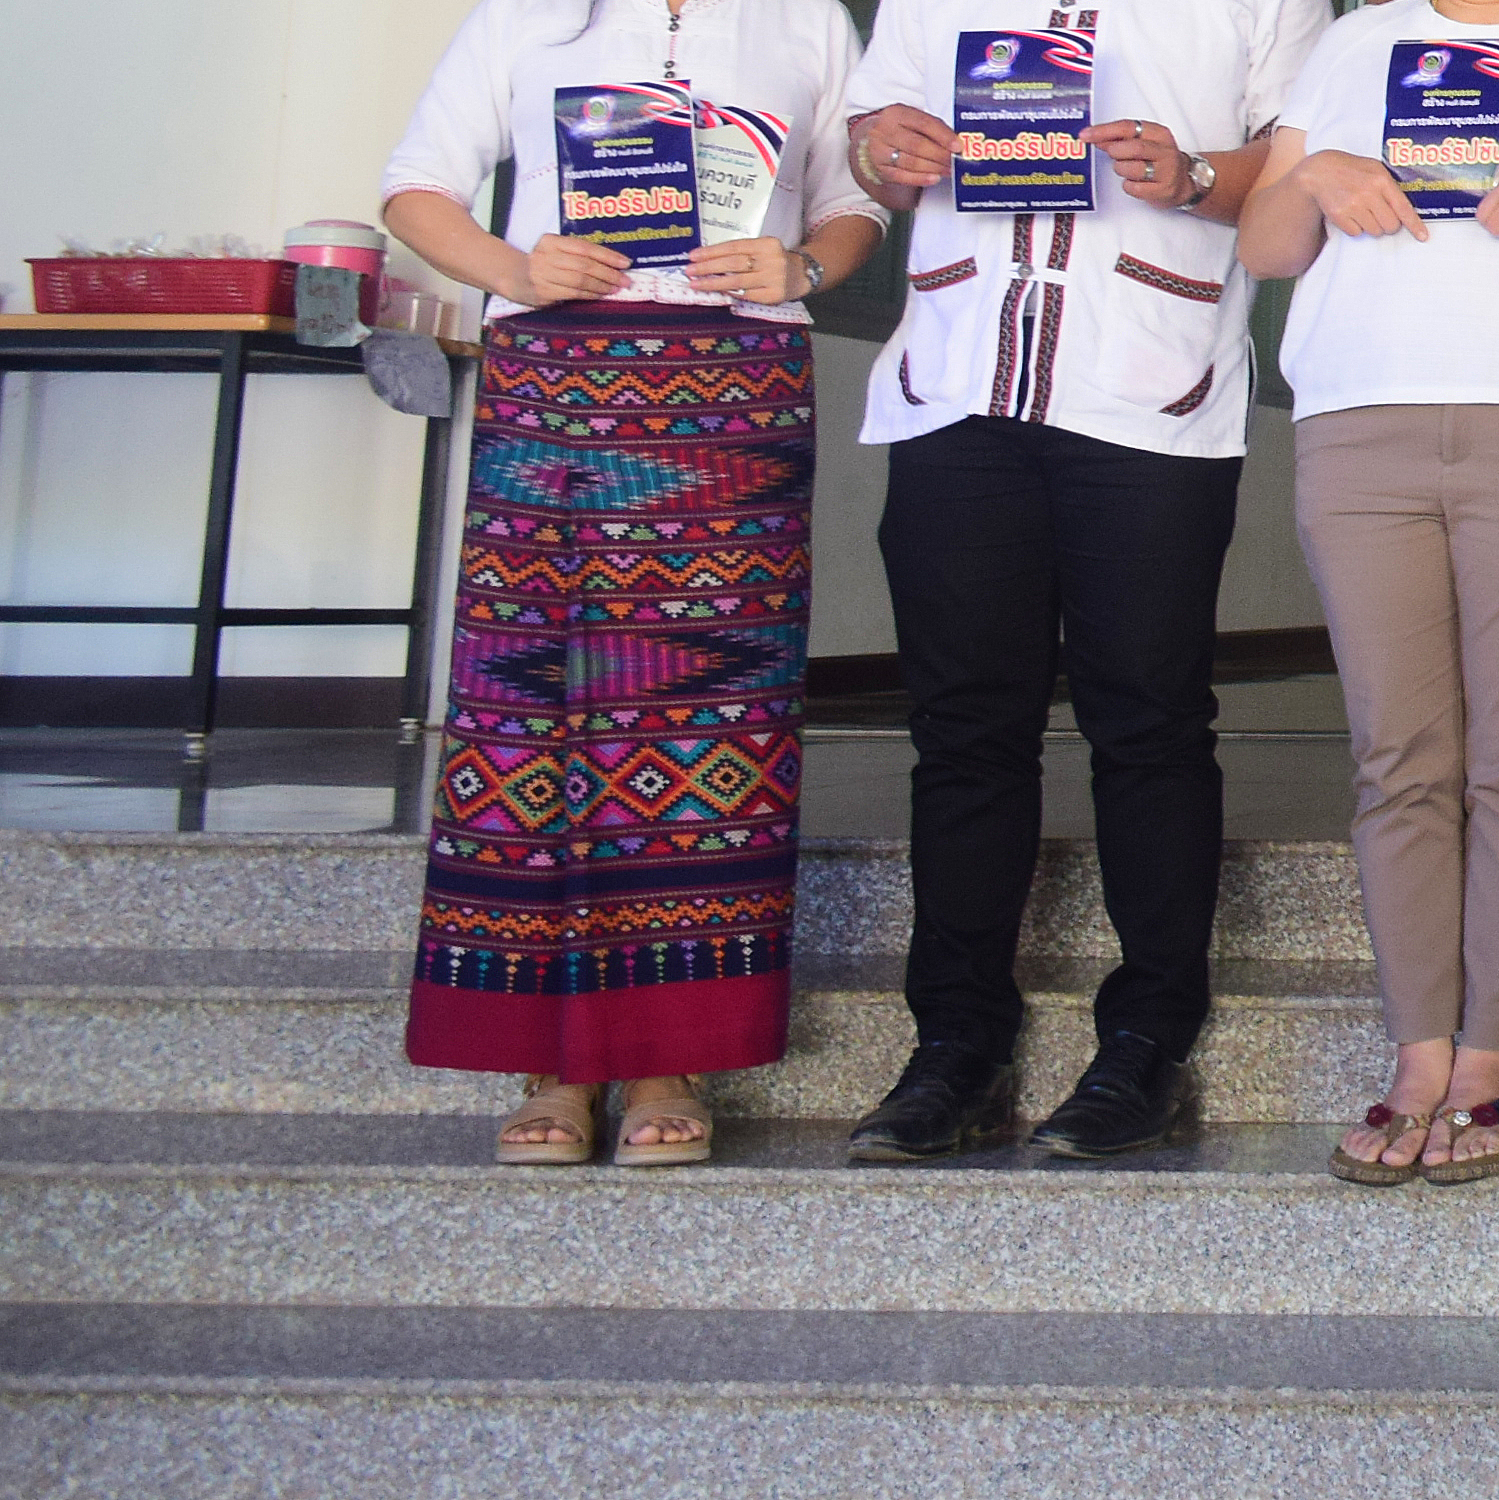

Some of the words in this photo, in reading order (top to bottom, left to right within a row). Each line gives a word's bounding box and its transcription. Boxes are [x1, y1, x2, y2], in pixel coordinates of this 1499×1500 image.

[960, 131, 1086, 160] ไร้คอร์รัปชัน
[562, 186, 693, 220] ไร้คอร์รัปชัน
